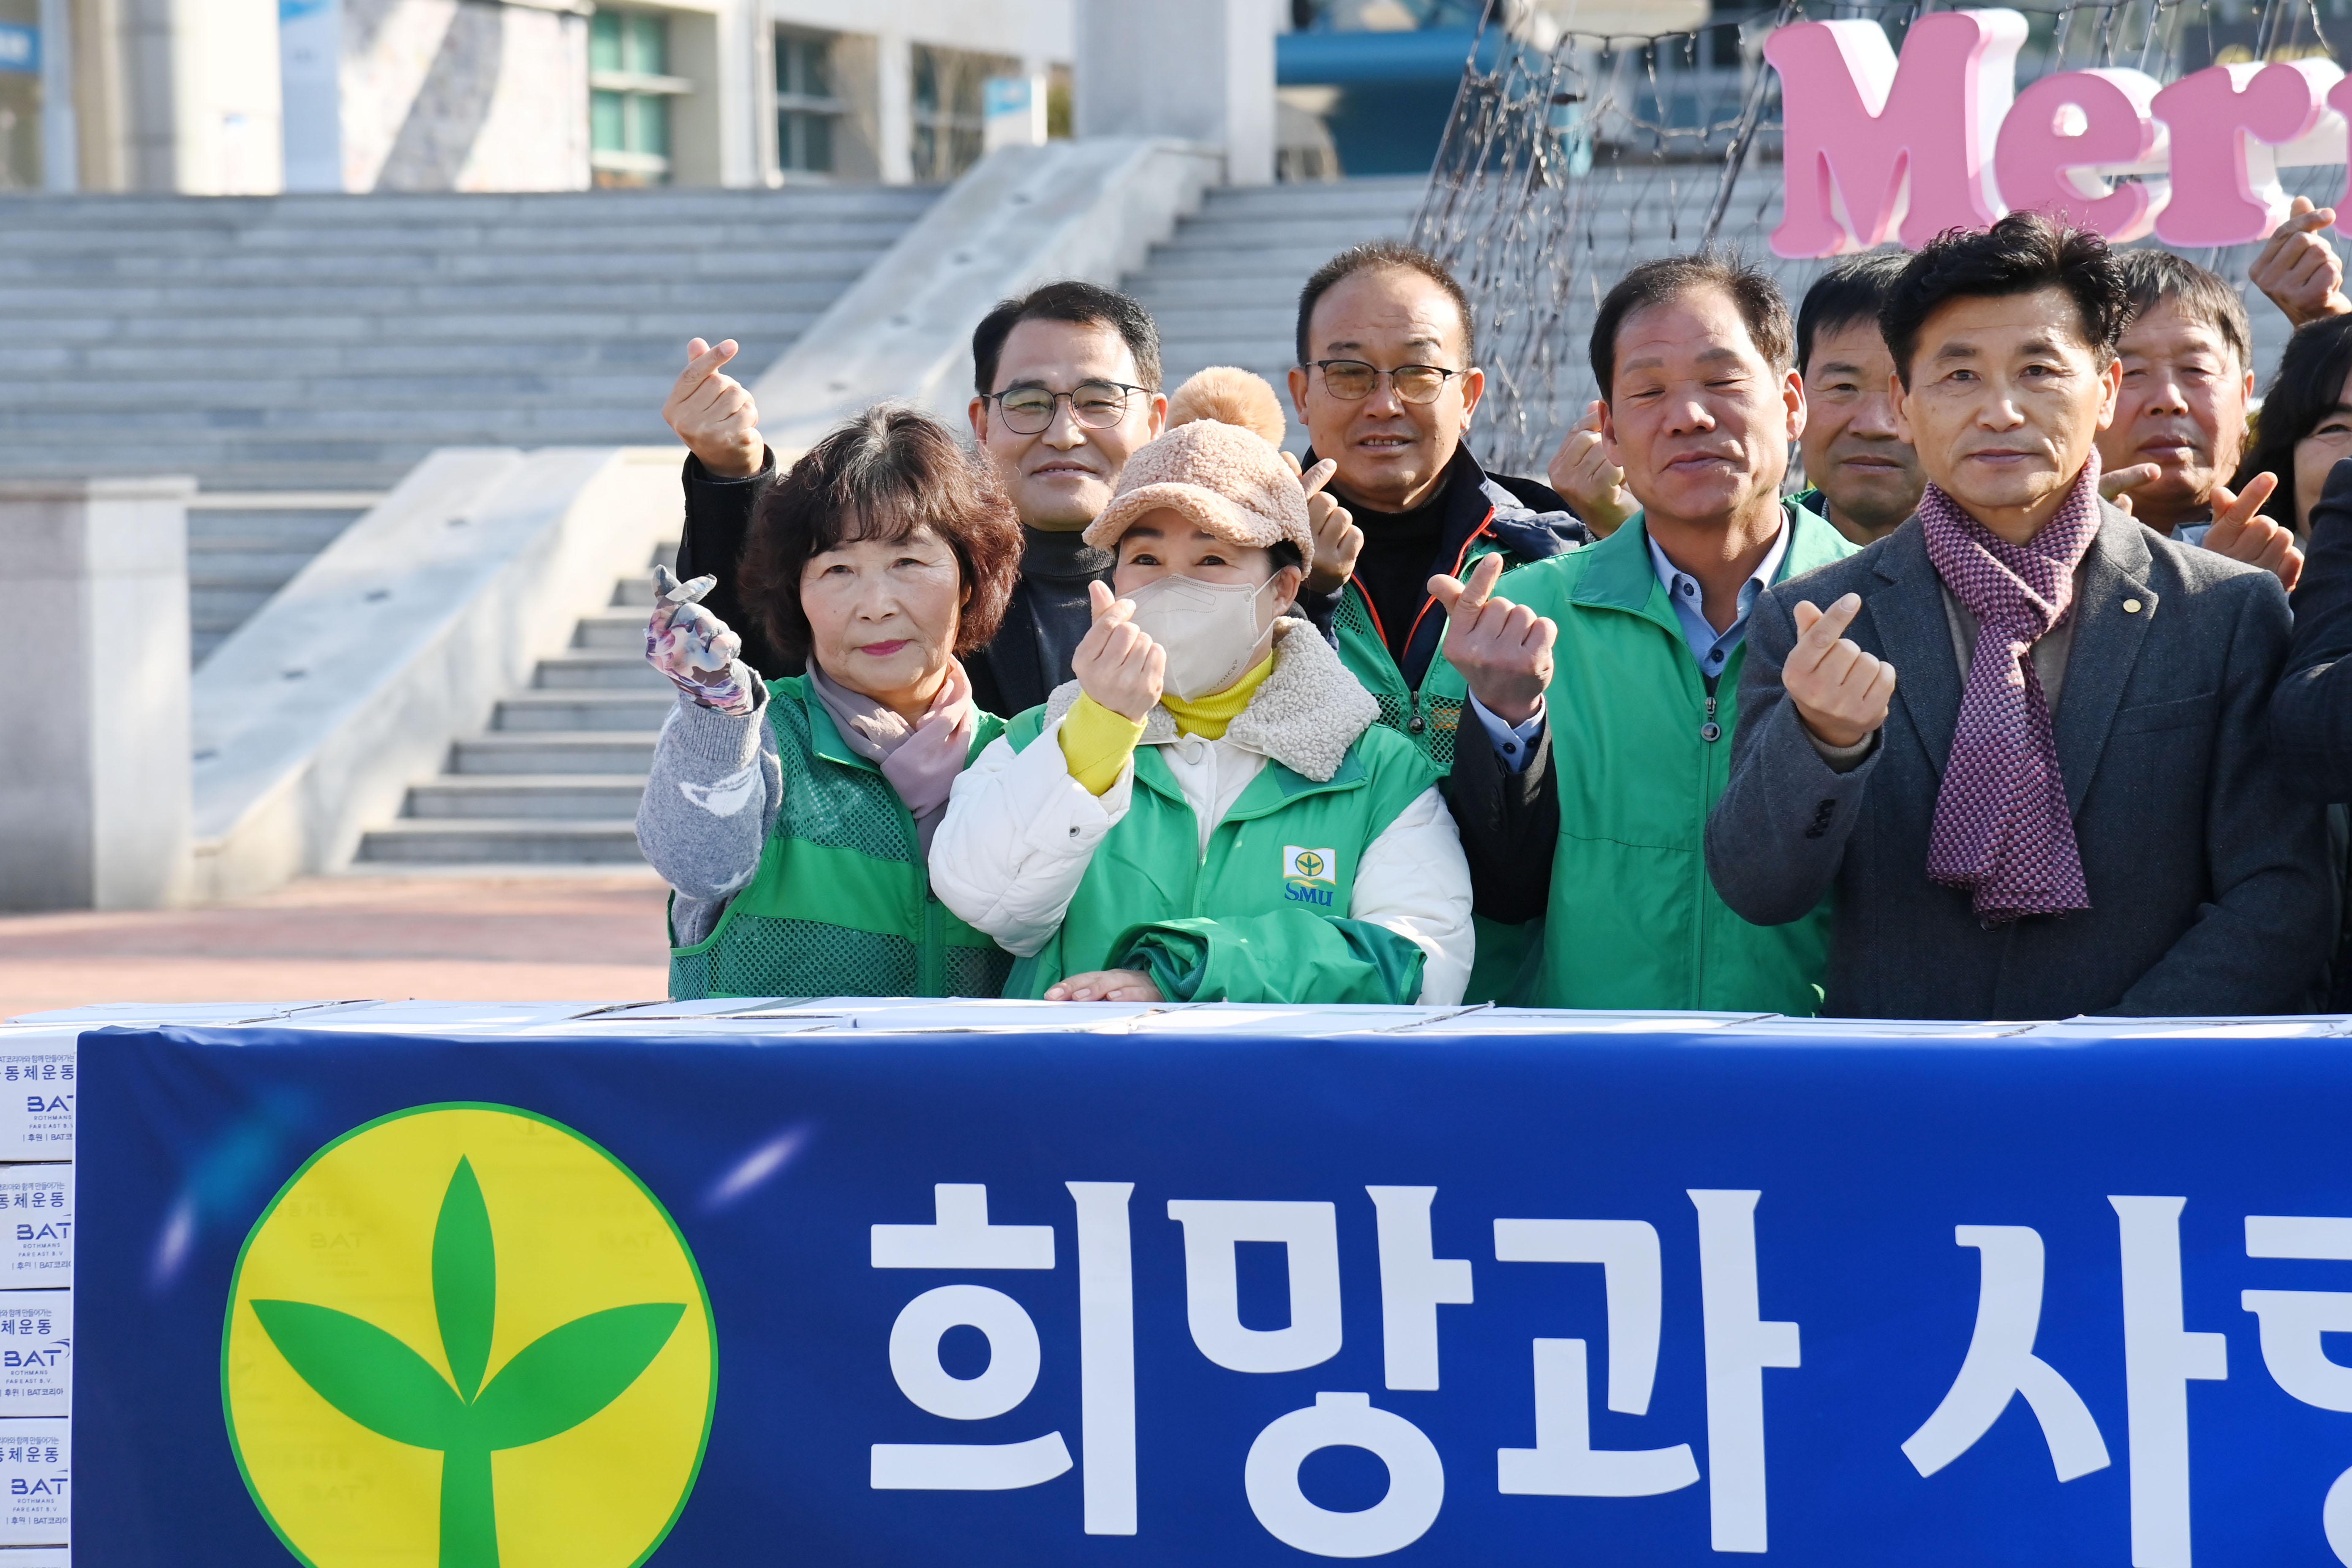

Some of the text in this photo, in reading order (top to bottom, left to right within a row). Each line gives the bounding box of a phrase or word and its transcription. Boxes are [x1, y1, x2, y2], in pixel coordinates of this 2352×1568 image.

[1762, 8, 2352, 259] Mer
[1284, 882, 1334, 906] SMU
[32, 1055, 44, 1063] 함께
[0, 1064, 74, 1081] 동체운동
[27, 1095, 74, 1112] BA
[22, 1182, 33, 1191] 함께
[17, 1222, 71, 1240] BAT
[9, 1309, 21, 1317] 함께
[5, 1350, 62, 1367] BAT
[870, 1181, 1802, 1559] 희망과
[17, 1437, 29, 1445] 함께
[11, 1478, 68, 1495] BAT
